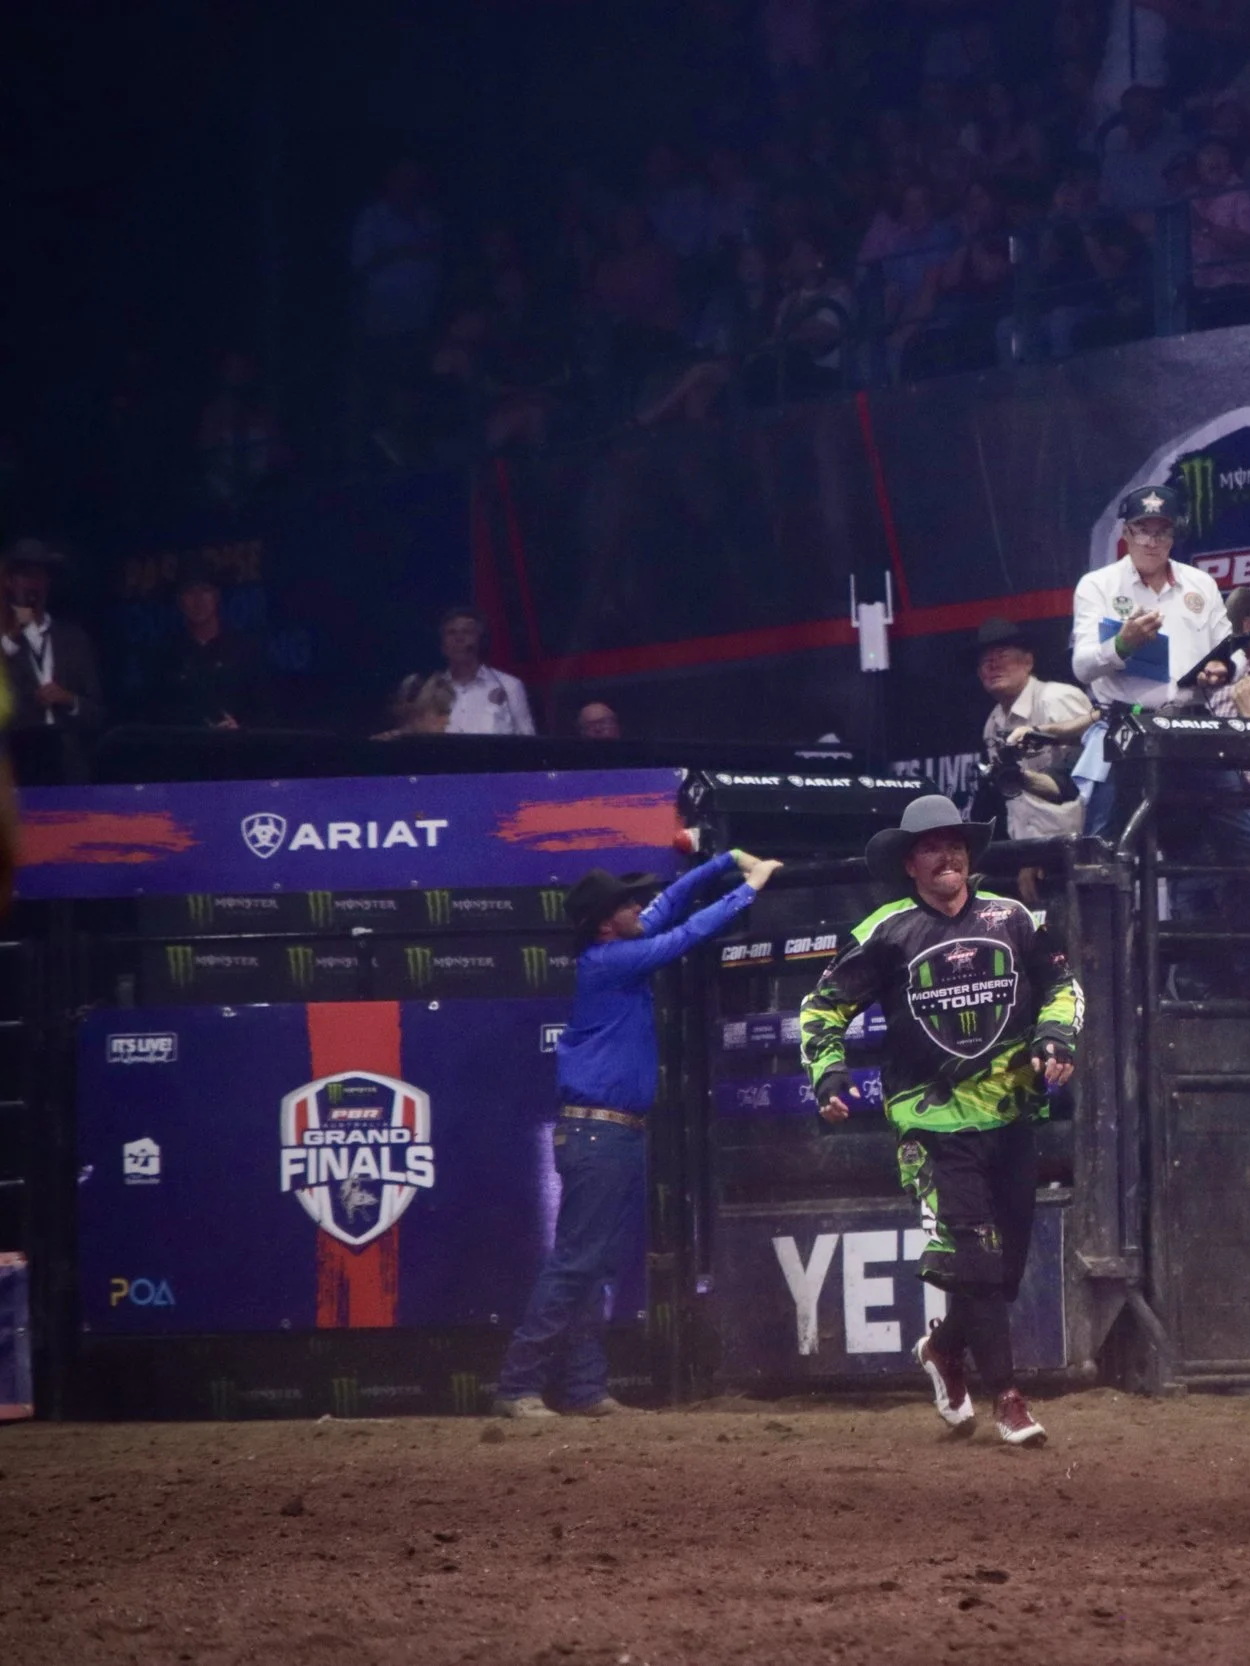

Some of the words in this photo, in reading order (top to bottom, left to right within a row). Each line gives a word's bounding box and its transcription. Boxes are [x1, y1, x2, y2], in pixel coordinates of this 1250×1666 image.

[1171, 719, 1221, 730] ARIAT
[733, 776, 780, 786] ARIAT
[803, 777, 852, 787] ARIAT
[874, 779, 923, 789] ARIAT
[287, 819, 449, 851] ARIAT
[214, 897, 279, 910] MONSTER
[334, 898, 397, 911] MONSTER
[452, 898, 513, 911] MONSTER
[721, 942, 772, 961] can-am
[784, 934, 838, 954] can-am
[912, 984, 969, 1001] MONSTER
[972, 979, 1014, 992] ENERGY
[938, 991, 994, 1010] TOUR
[303, 1128, 412, 1146] GRAND
[280, 1145, 436, 1192] FINALS
